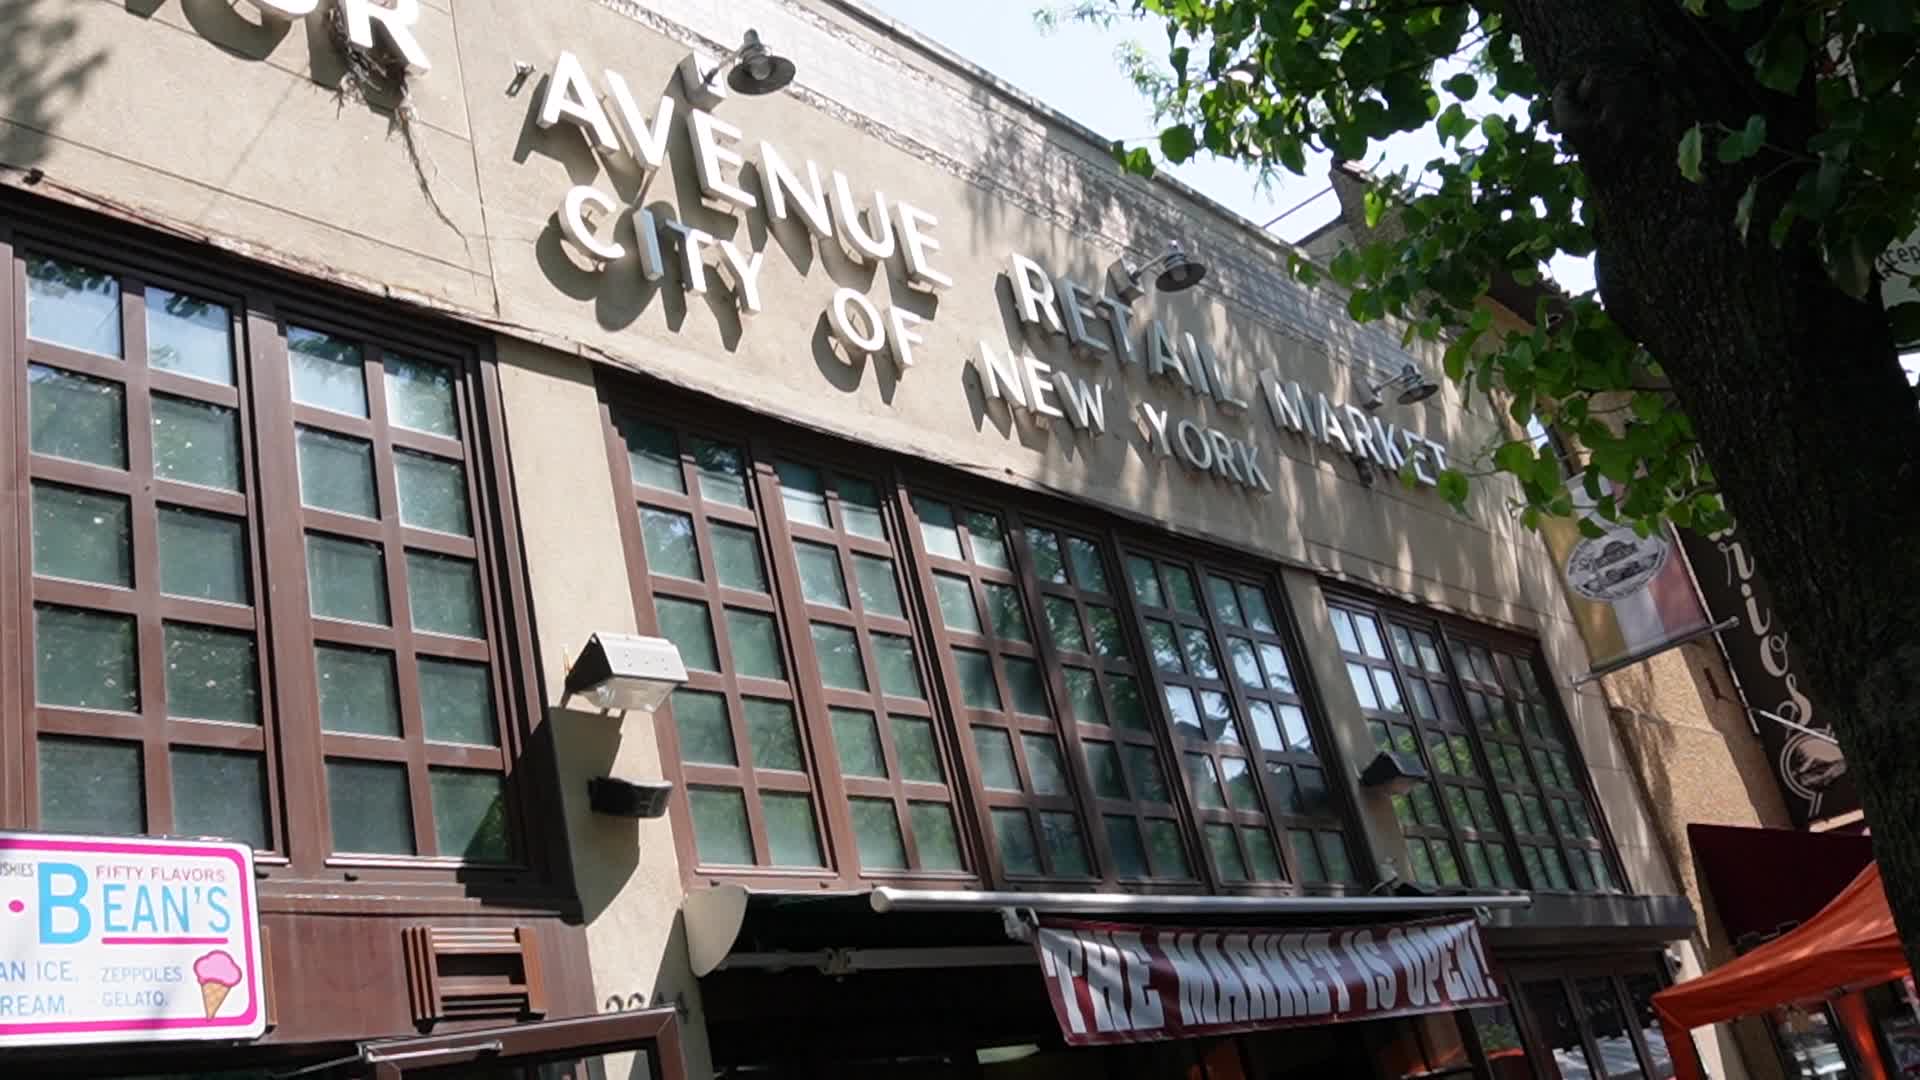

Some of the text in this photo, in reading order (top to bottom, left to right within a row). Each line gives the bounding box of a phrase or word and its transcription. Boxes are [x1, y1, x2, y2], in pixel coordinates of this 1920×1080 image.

[537, 50, 952, 290] AVENUE
[1008, 253, 1249, 410] RETAIL
[1260, 368, 1448, 487] MARKET
[558, 184, 1273, 494] CITY OF NEW YORK
[38, 862, 231, 944] BEAN'S
[96, 865, 225, 882] FIFTY FLAVORS
[1038, 919, 1499, 1034] THE MARKET IS OPEN!
